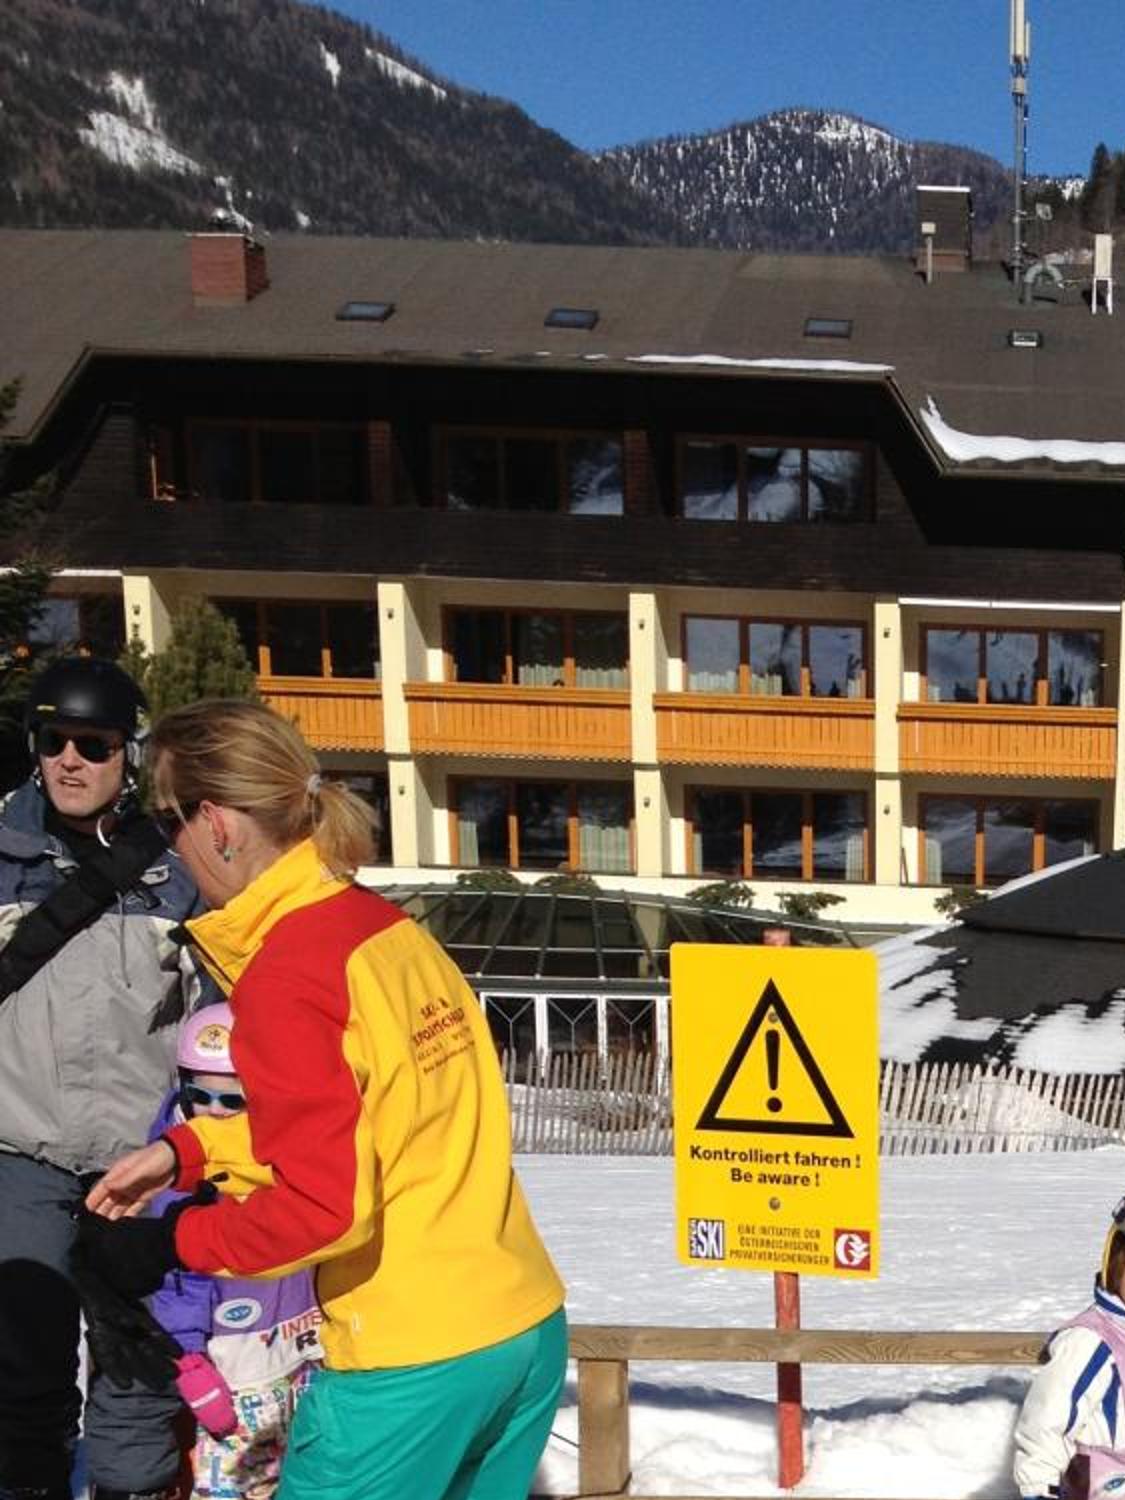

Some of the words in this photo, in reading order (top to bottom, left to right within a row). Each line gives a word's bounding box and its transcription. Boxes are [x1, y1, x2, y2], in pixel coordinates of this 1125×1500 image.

[690, 1145, 790, 1165] Kontrolliert
[794, 1152, 851, 1168] fahren
[731, 1168, 752, 1182] Be
[758, 1172, 810, 1186] aware
[697, 1220, 723, 1258] SKI
